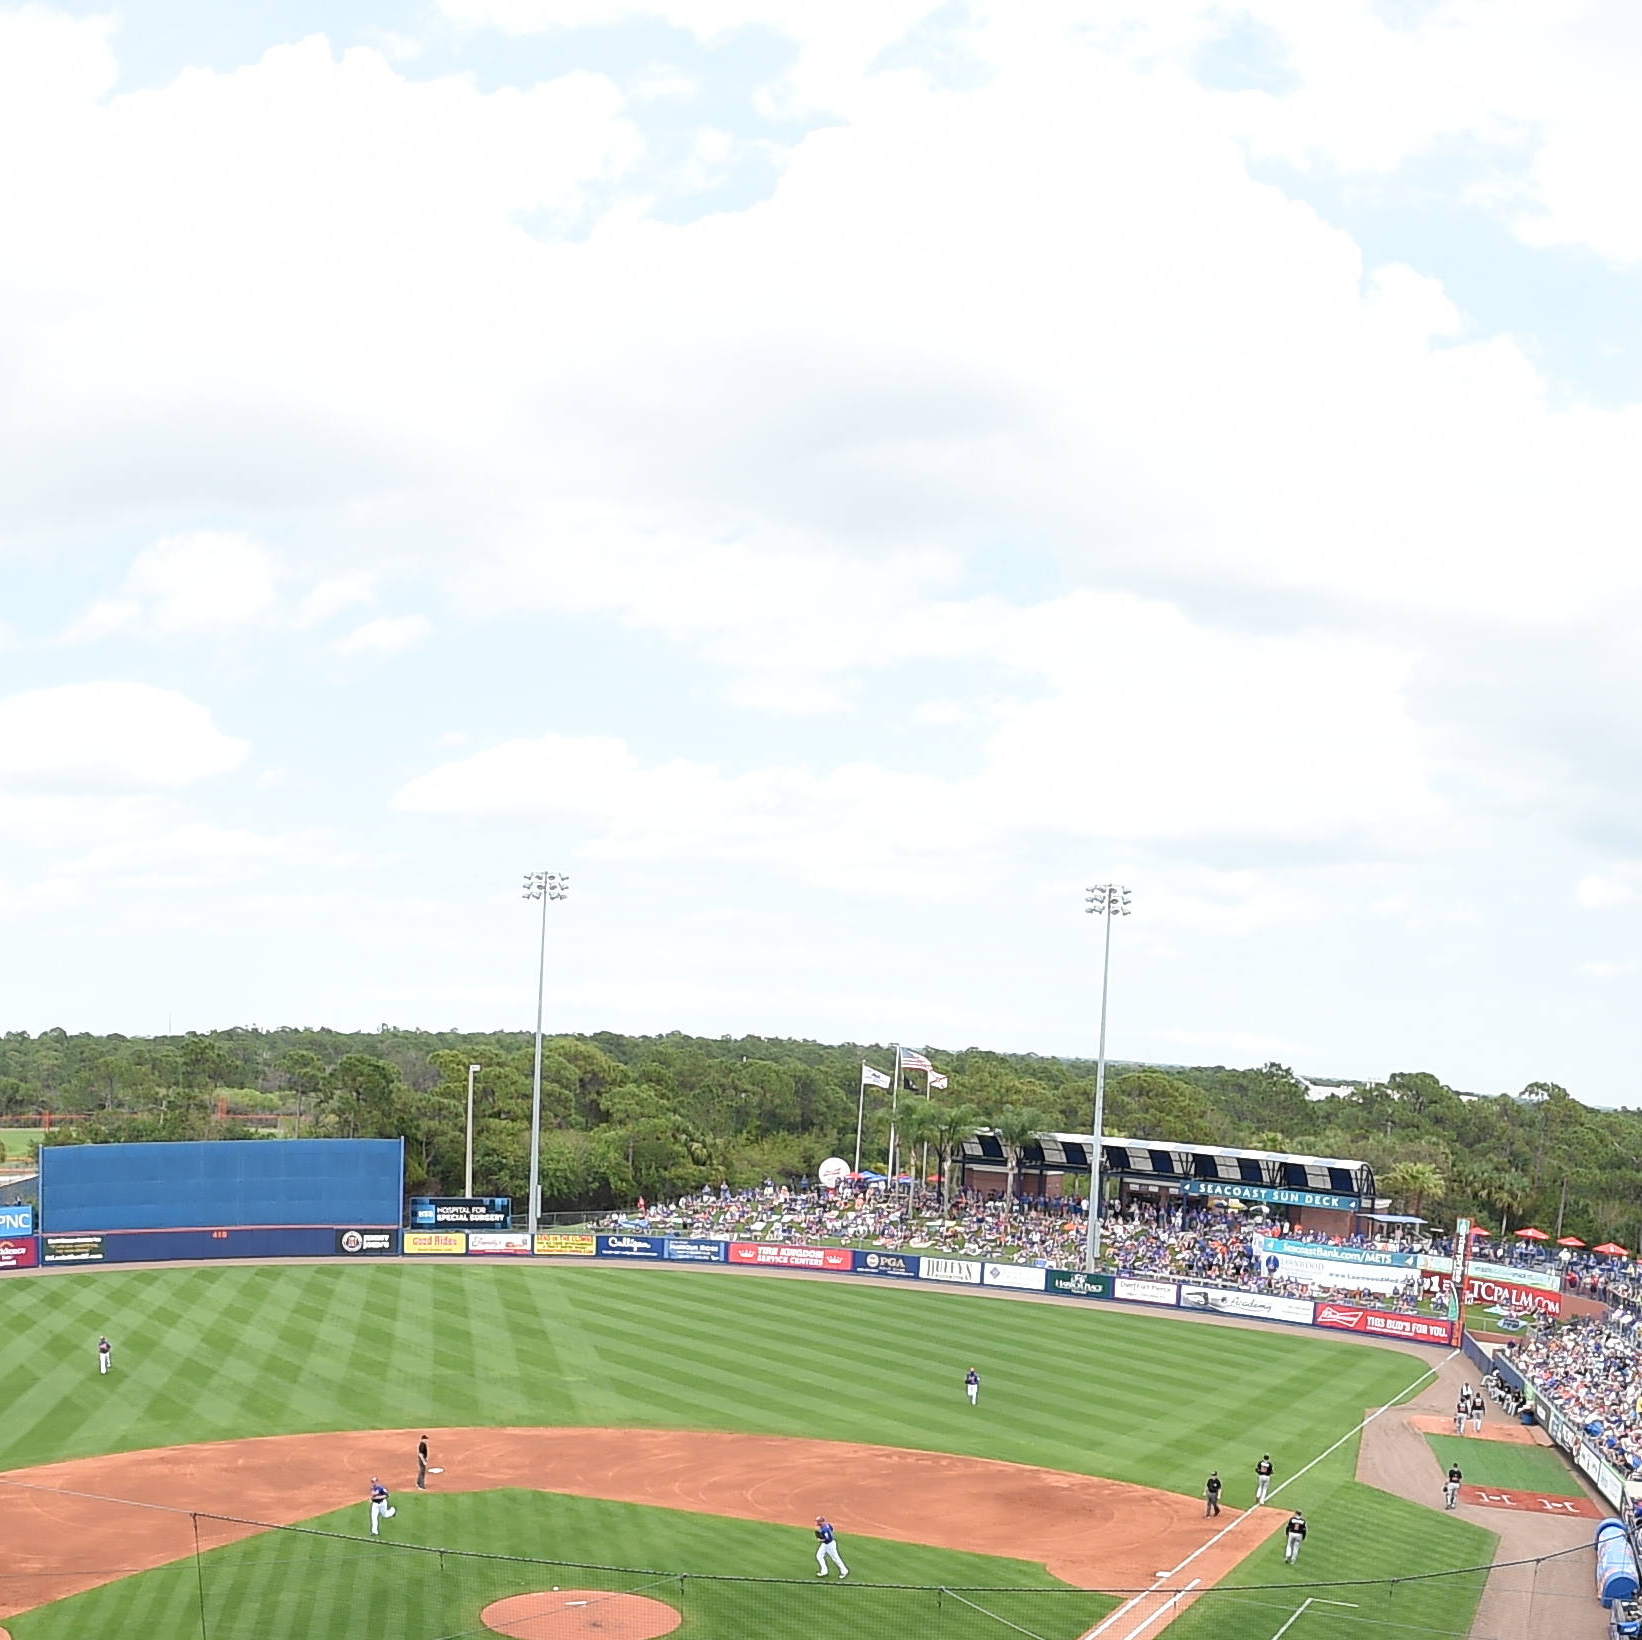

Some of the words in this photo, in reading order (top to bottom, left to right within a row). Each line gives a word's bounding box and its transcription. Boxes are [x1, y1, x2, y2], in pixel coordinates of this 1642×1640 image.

[1199, 1183, 1267, 1199] SEACOAST
[1272, 1191, 1299, 1202] SUN
[1305, 1195, 1339, 1207] DECK
[437, 1206, 470, 1214] HOSPITAL
[471, 1206, 486, 1214] FOR
[437, 1214, 468, 1222] SPECIAL
[470, 1214, 505, 1222] SURGERY
[779, 1247, 825, 1259] KINGDOM
[1283, 1243, 1392, 1264] SeacoastBank.com/METS
[790, 1257, 823, 1266] CENTERS
[880, 1256, 905, 1268] PGA
[1367, 1316, 1385, 1326] THIS
[1386, 1319, 1410, 1331] BUD'S
[1412, 1323, 1428, 1335] FOR
